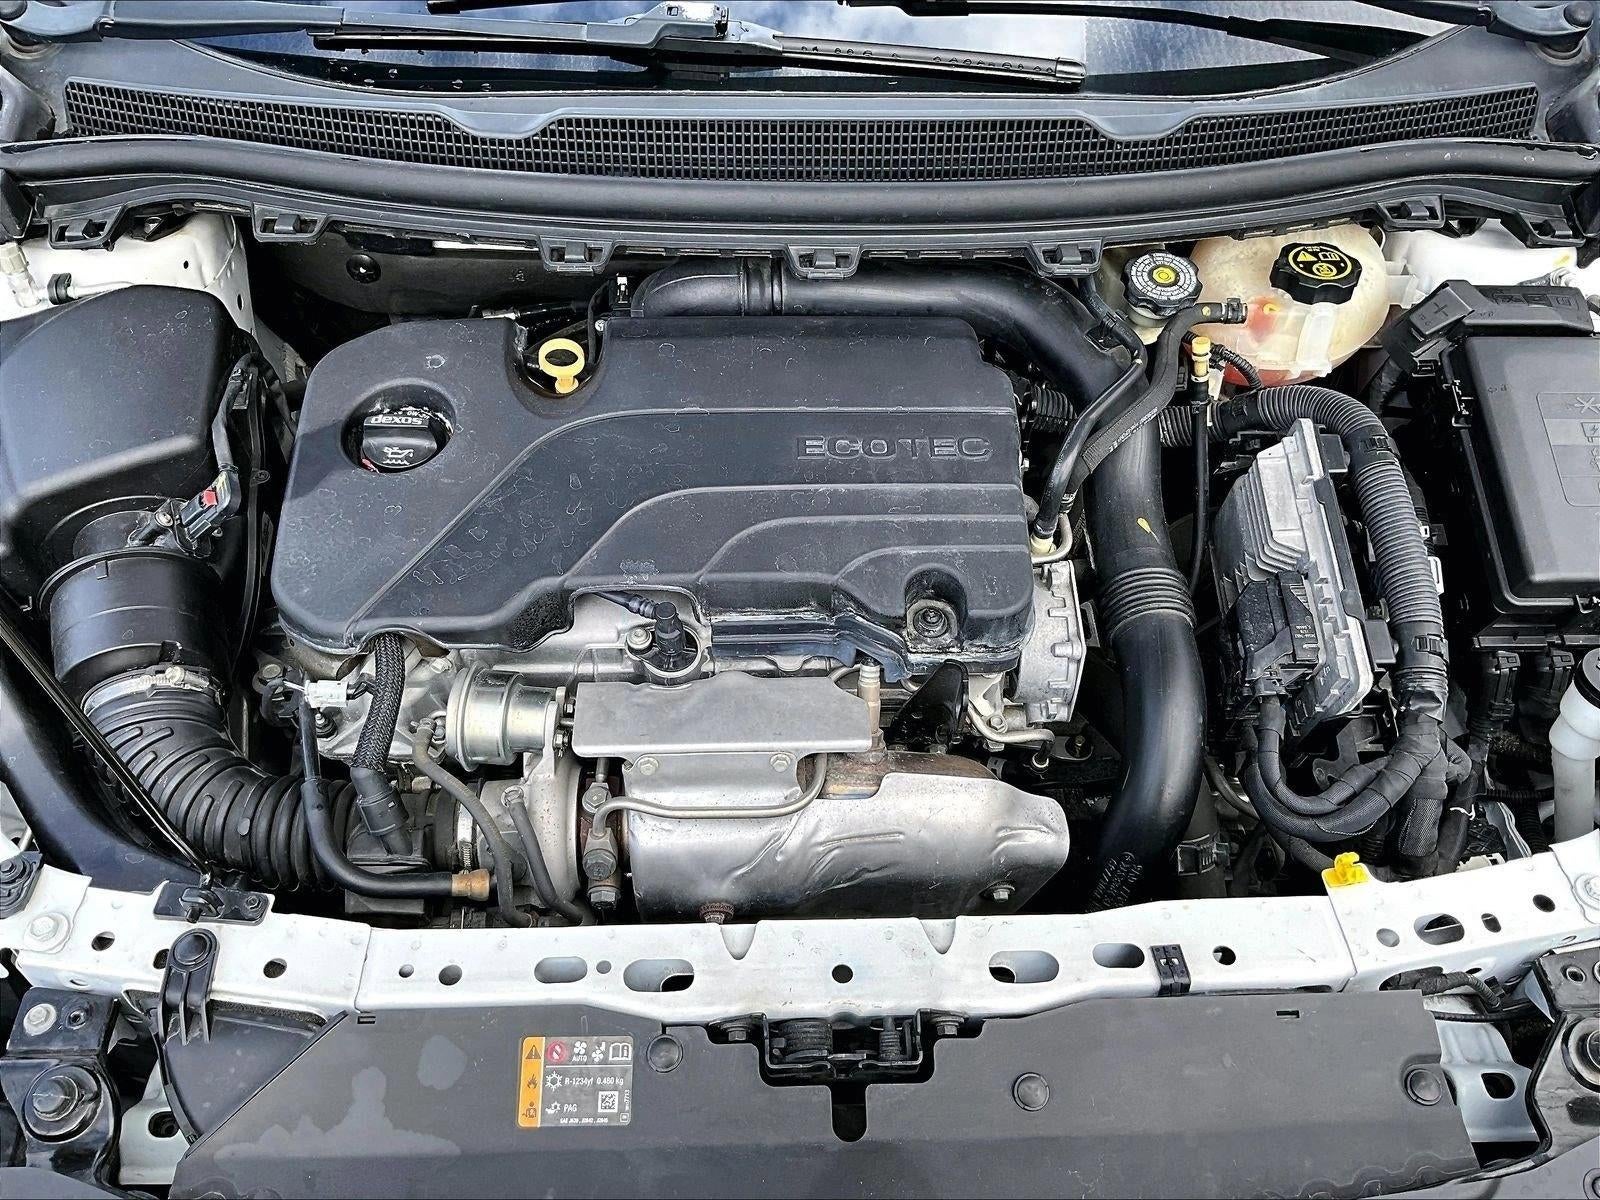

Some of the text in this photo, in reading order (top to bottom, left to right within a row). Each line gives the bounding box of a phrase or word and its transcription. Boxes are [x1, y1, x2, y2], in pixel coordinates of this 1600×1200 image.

[370, 414, 423, 425] dexos
[796, 435, 991, 461] ECOTEC
[571, 1054, 587, 1062] AUTO
[564, 1076, 594, 1088] R-1234yf
[615, 1076, 624, 1087] kg
[563, 1103, 578, 1113] PAG
